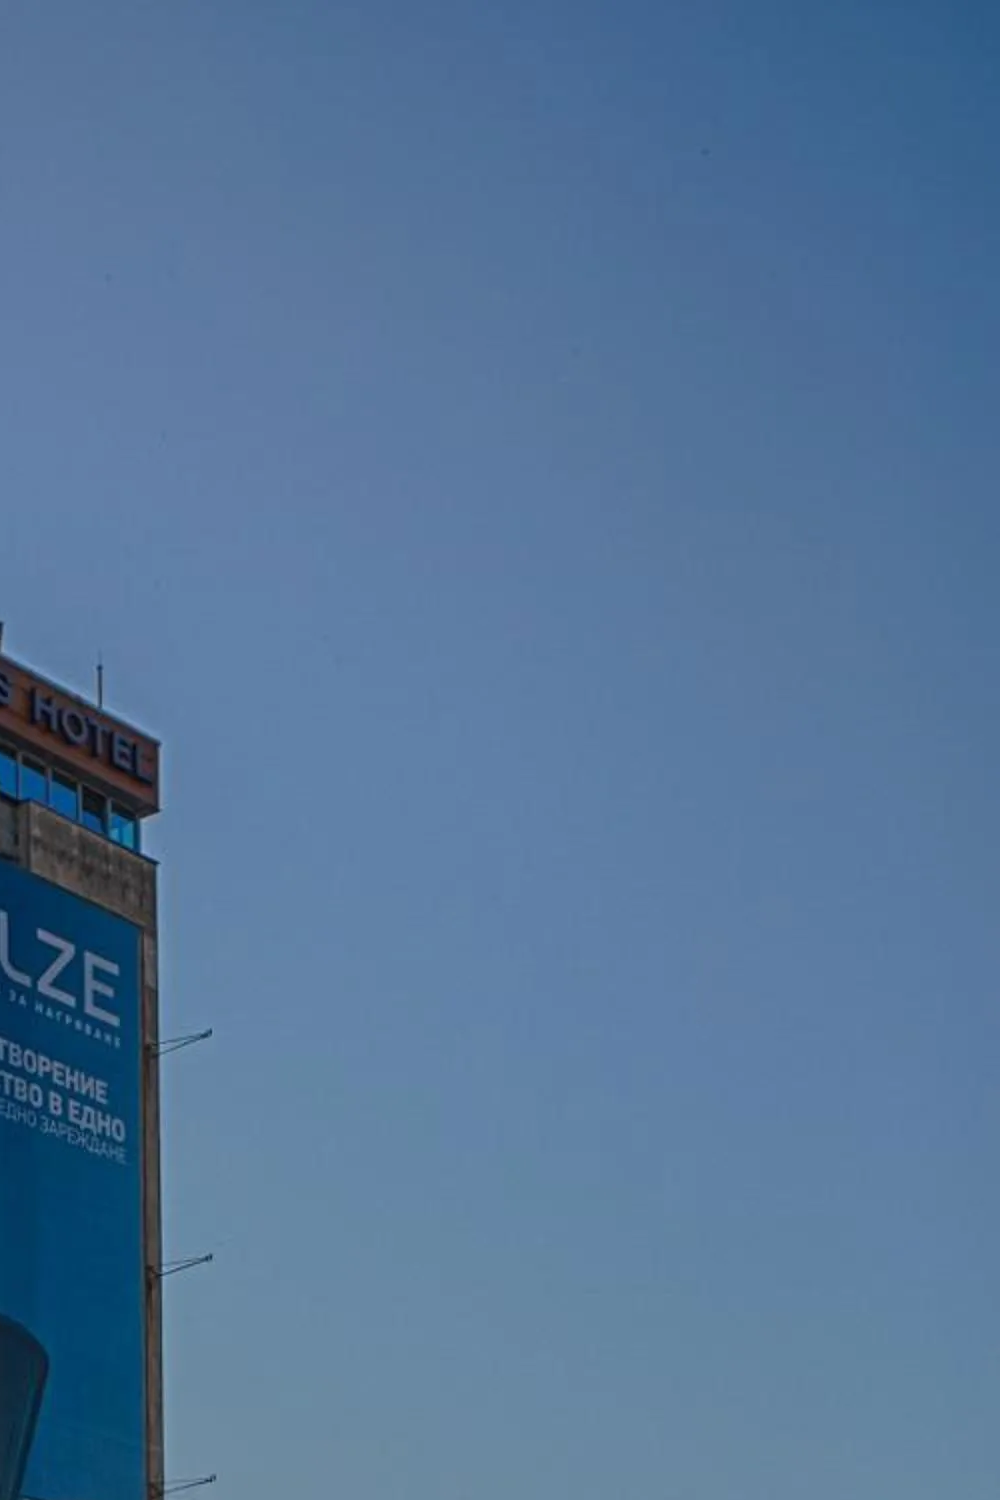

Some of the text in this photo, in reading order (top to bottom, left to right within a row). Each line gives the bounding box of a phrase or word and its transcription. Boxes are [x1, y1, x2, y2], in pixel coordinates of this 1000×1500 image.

[31, 686, 156, 786] HOTEL
[40, 1113, 128, 1165] ЗАРЕЖДАНЕ
[49, 1091, 64, 1116] В
[67, 1099, 127, 1143] ЕДНО
